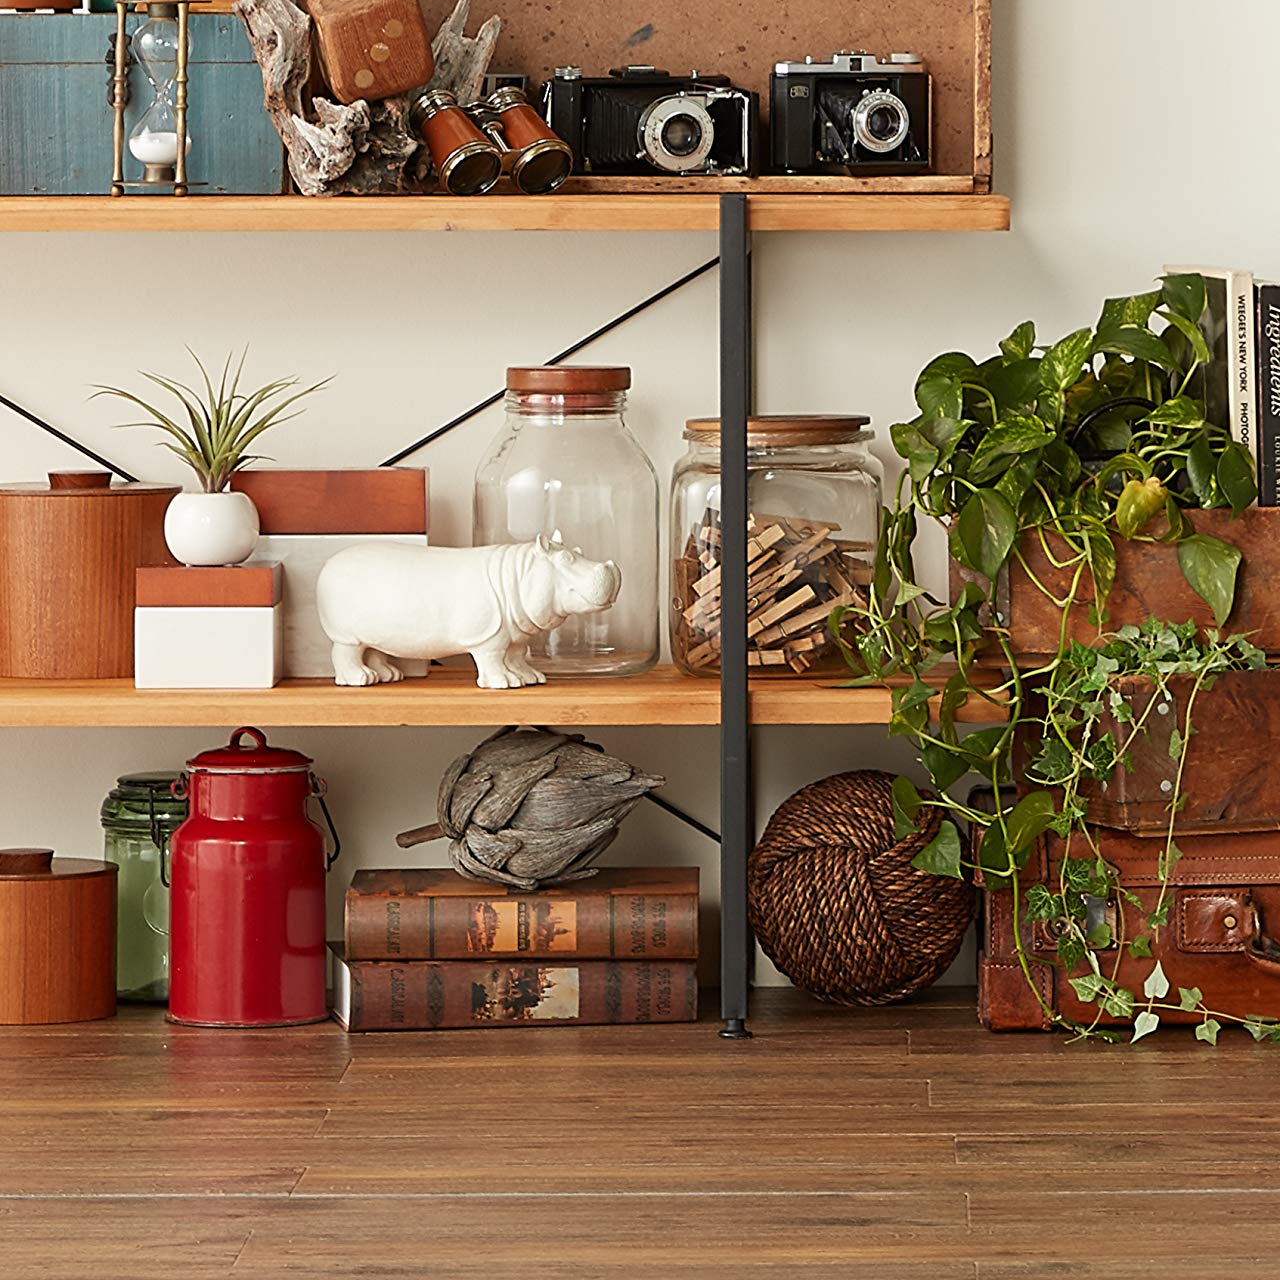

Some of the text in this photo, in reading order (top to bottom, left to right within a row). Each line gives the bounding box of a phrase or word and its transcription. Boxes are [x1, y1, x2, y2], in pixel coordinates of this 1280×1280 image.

[1237, 295, 1247, 339] WEEGEE'S
[1238, 341, 1247, 365] NEW
[1239, 366, 1249, 392] YORK
